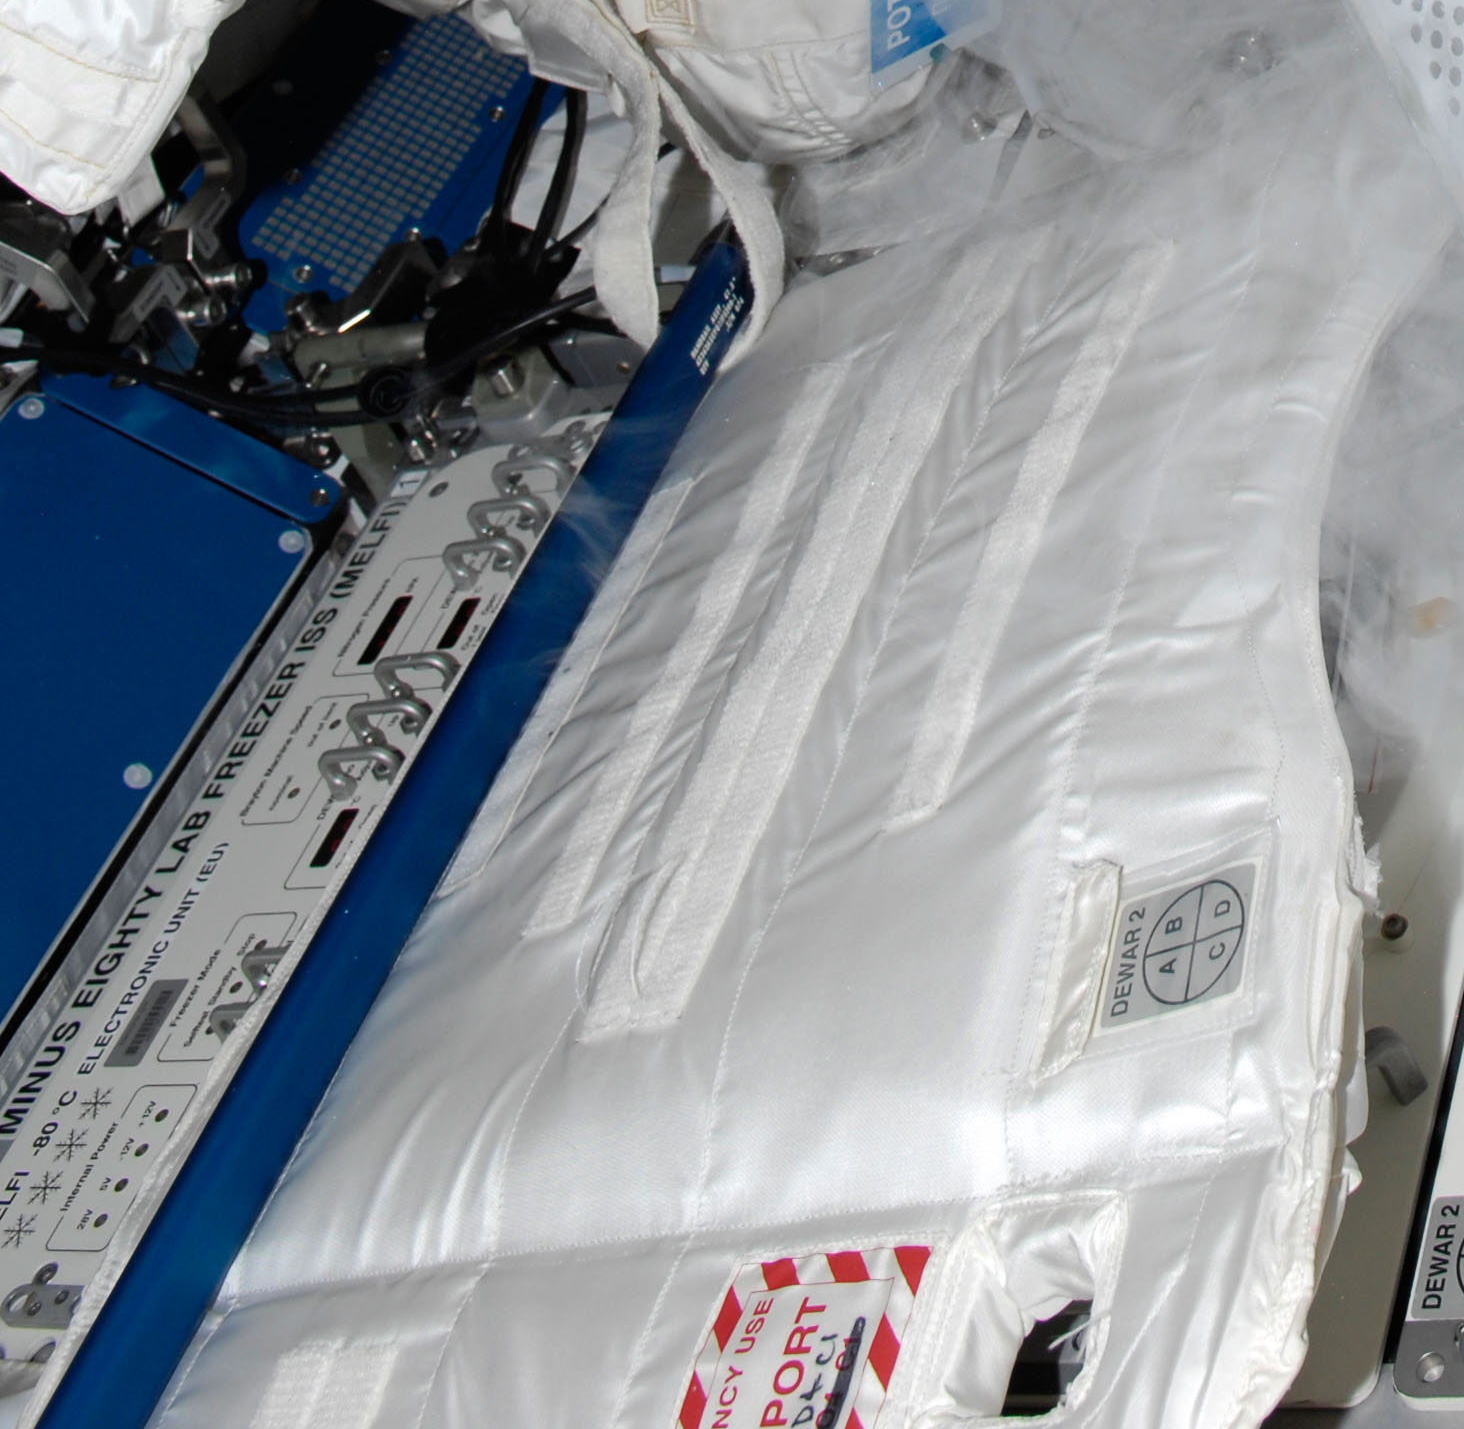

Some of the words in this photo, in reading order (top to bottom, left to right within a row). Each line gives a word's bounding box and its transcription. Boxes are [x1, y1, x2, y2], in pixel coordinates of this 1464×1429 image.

[239, 778, 268, 817] Brayton
[263, 737, 293, 777] Machine
[289, 705, 312, 735] Speed
[0, 1017, 82, 1134] MINUS
[71, 883, 164, 1008] EIGHTY
[155, 810, 212, 871] LAB
[201, 657, 305, 798] FREEZER
[294, 606, 339, 651] ISS
[329, 497, 407, 598] (MELFI)
[396, 470, 420, 493] 1
[1165, 916, 1183, 936] B
[1214, 900, 1232, 917] D
[77, 941, 170, 1075] ELECTRONIC
[164, 879, 200, 931] UNIT
[197, 842, 230, 885] (EU)
[168, 983, 200, 1026] Freezer
[197, 947, 222, 980] Mode
[207, 964, 236, 1004] Standby
[235, 932, 256, 955] Stop
[1109, 927, 1141, 1018] DEWAR
[1130, 907, 1146, 921] 2
[1157, 958, 1175, 975] A
[1208, 941, 1226, 961] C
[28, 1119, 59, 1157] -80
[60, 1162, 94, 1212] Internal
[91, 1121, 118, 1160] Power
[76, 1208, 94, 1230] 28V
[1422, 1224, 1456, 1310] DEWAR
[1442, 1205, 1459, 1218] 2
[734, 1297, 774, 1353] USE
[758, 1295, 827, 1425] PORT
